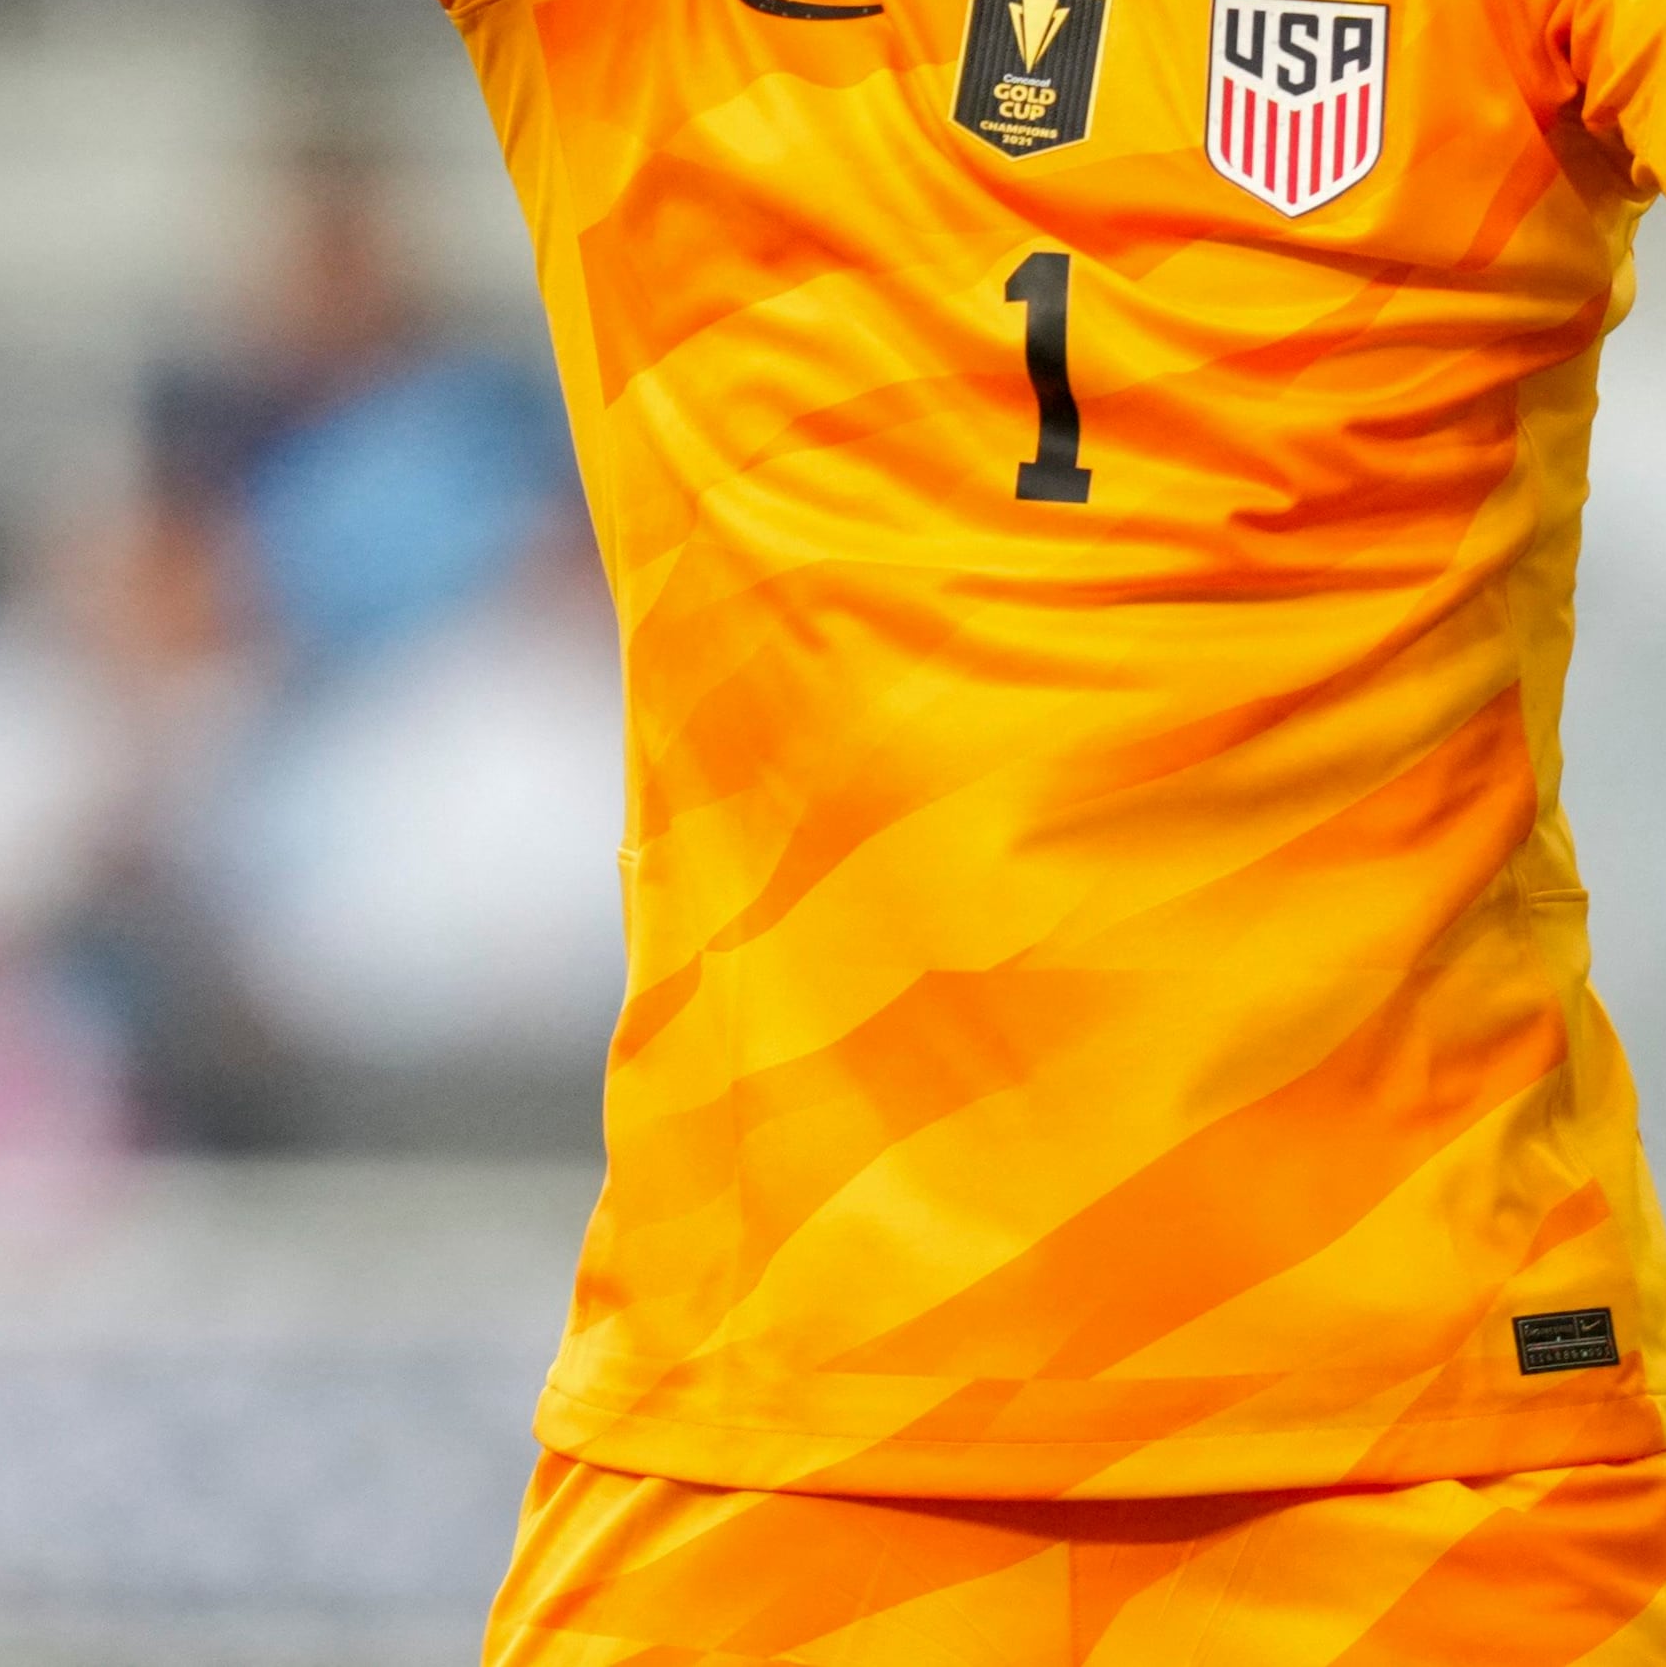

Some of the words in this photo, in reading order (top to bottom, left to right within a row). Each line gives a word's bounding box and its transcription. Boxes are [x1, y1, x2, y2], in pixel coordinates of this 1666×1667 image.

[1225, 8, 1373, 96] USA
[993, 83, 1057, 105] GOLD
[999, 101, 1046, 121] CUP
[979, 120, 1059, 139] CHAMPIONS
[1002, 134, 1033, 147] 2021
[1004, 252, 1092, 504] 1
